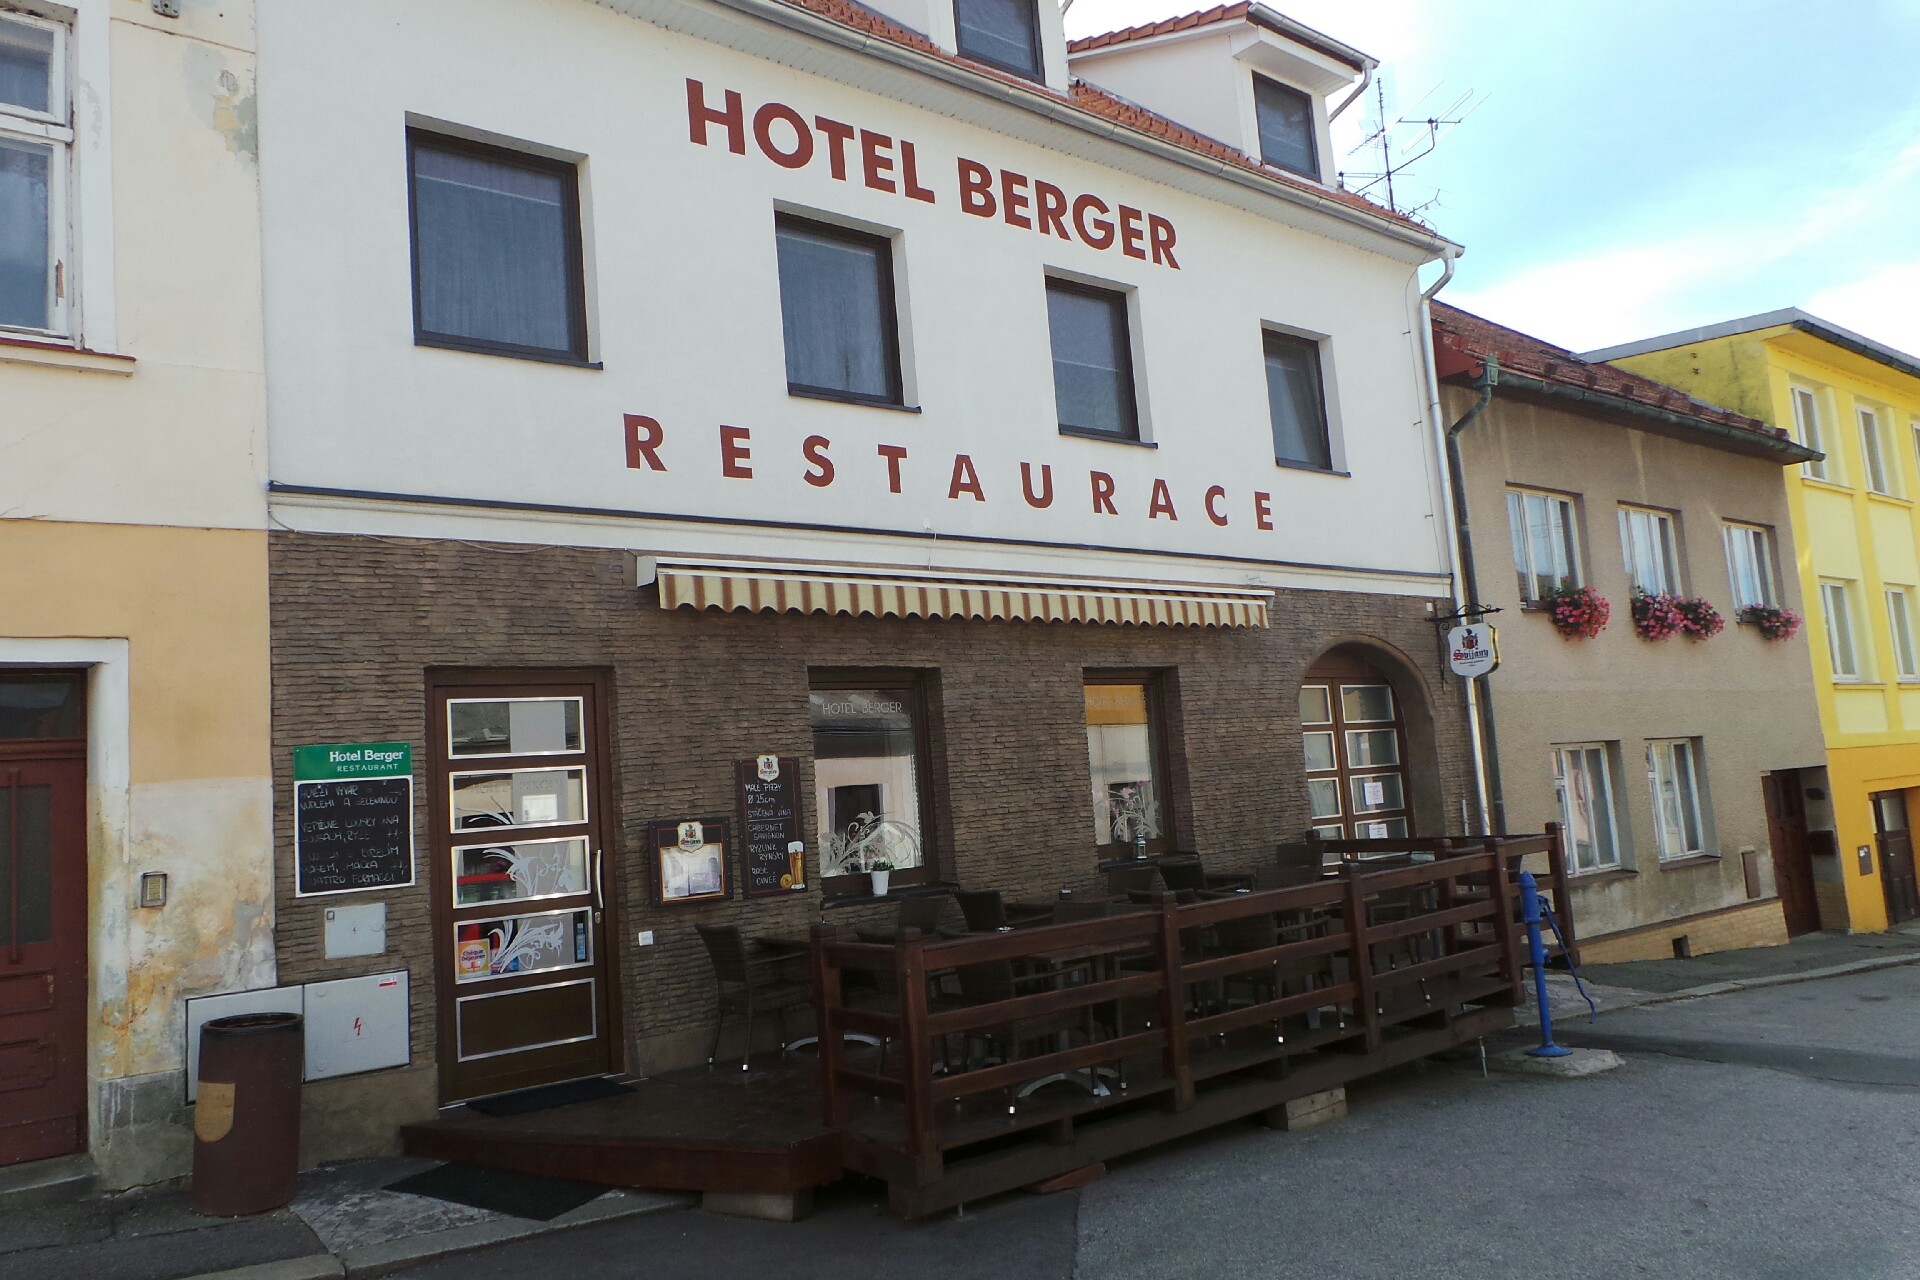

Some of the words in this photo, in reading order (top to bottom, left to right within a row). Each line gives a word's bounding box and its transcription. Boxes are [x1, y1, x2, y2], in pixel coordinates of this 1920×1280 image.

[687, 79, 935, 204] HOTEL
[957, 159, 1179, 269] BERGER
[625, 415, 1273, 531] RESTAURACE
[822, 702, 857, 715] HOTEL
[863, 701, 902, 713] BERGER
[329, 750, 361, 762] Hotel
[364, 749, 404, 763] Berger
[337, 763, 399, 772] RESTAURANT
